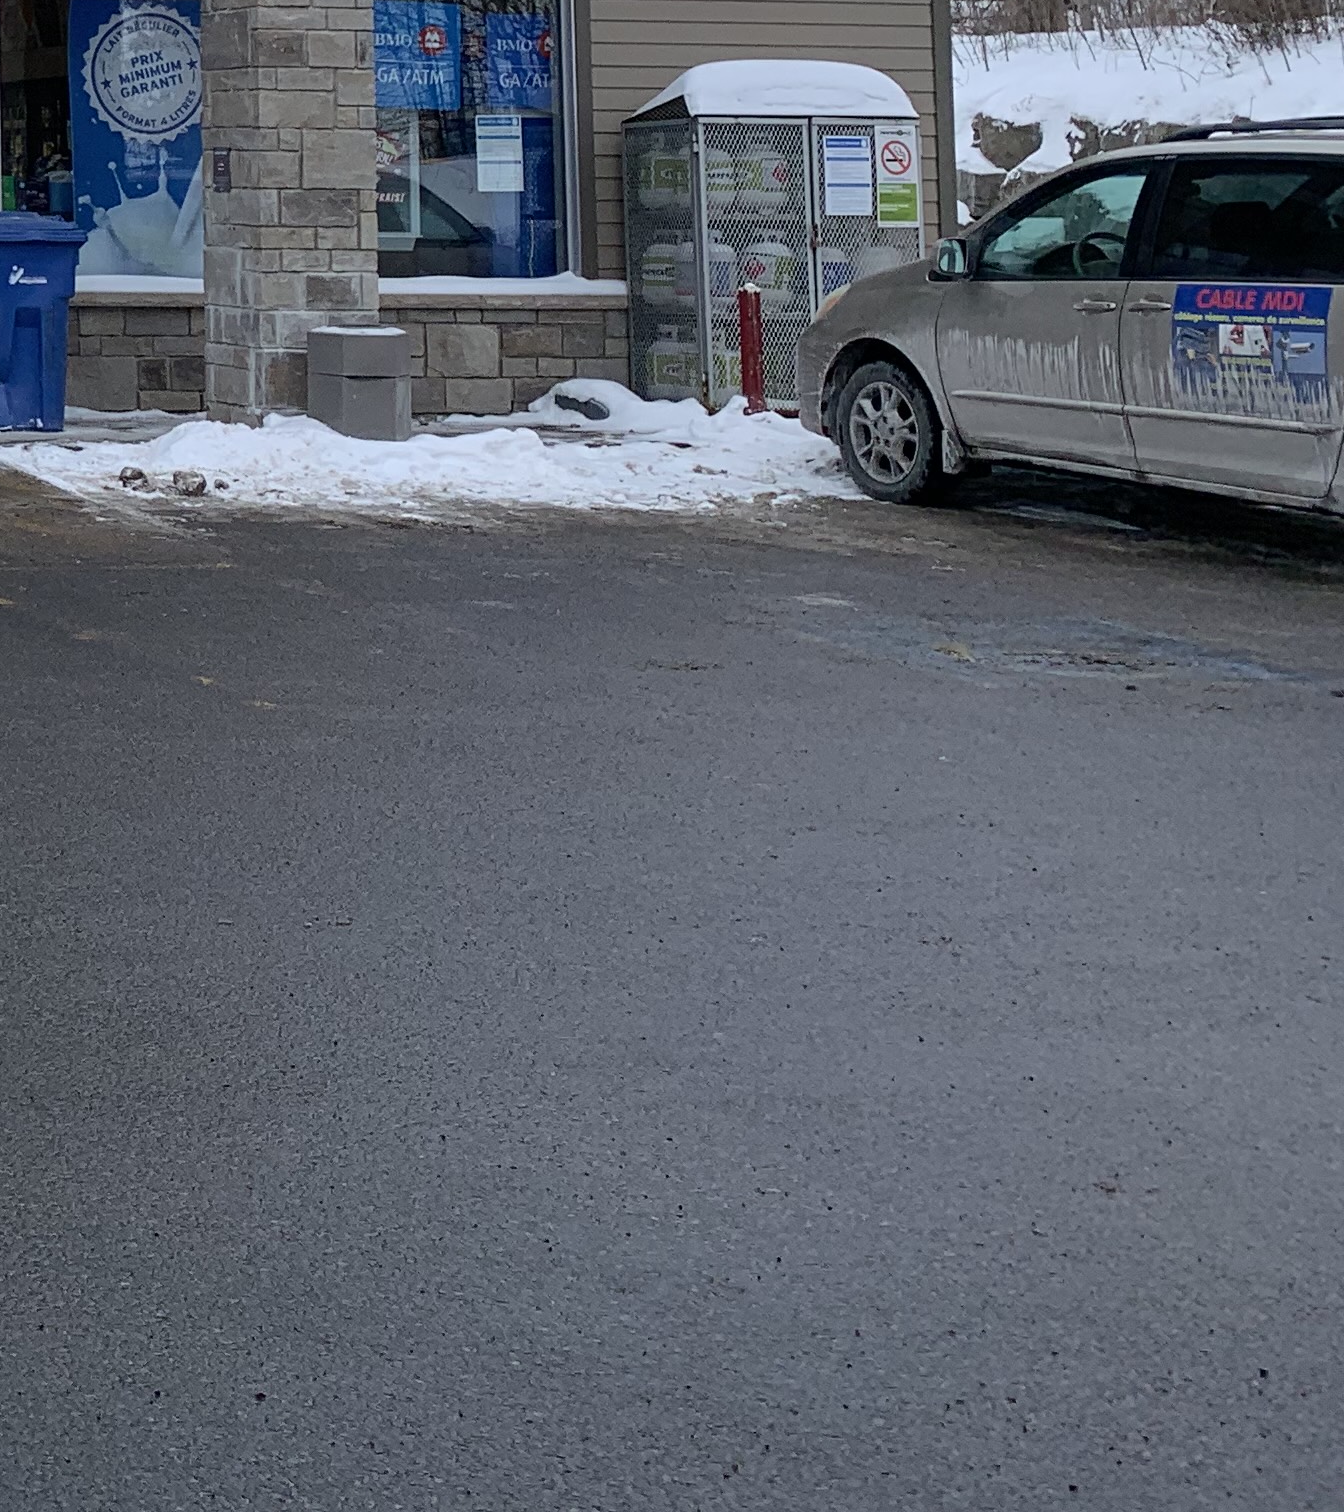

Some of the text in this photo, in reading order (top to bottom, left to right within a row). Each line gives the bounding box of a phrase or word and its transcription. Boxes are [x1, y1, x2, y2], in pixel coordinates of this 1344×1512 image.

[104, 31, 123, 53] LAIT
[375, 33, 412, 48] BMO
[496, 39, 533, 51] BMO
[130, 50, 164, 68] PRIX
[118, 60, 183, 86] MINIMUM
[120, 74, 184, 99] GARANTI
[115, 89, 197, 128] FORMAT 4 LITRES
[1261, 290, 1306, 313] MDI
